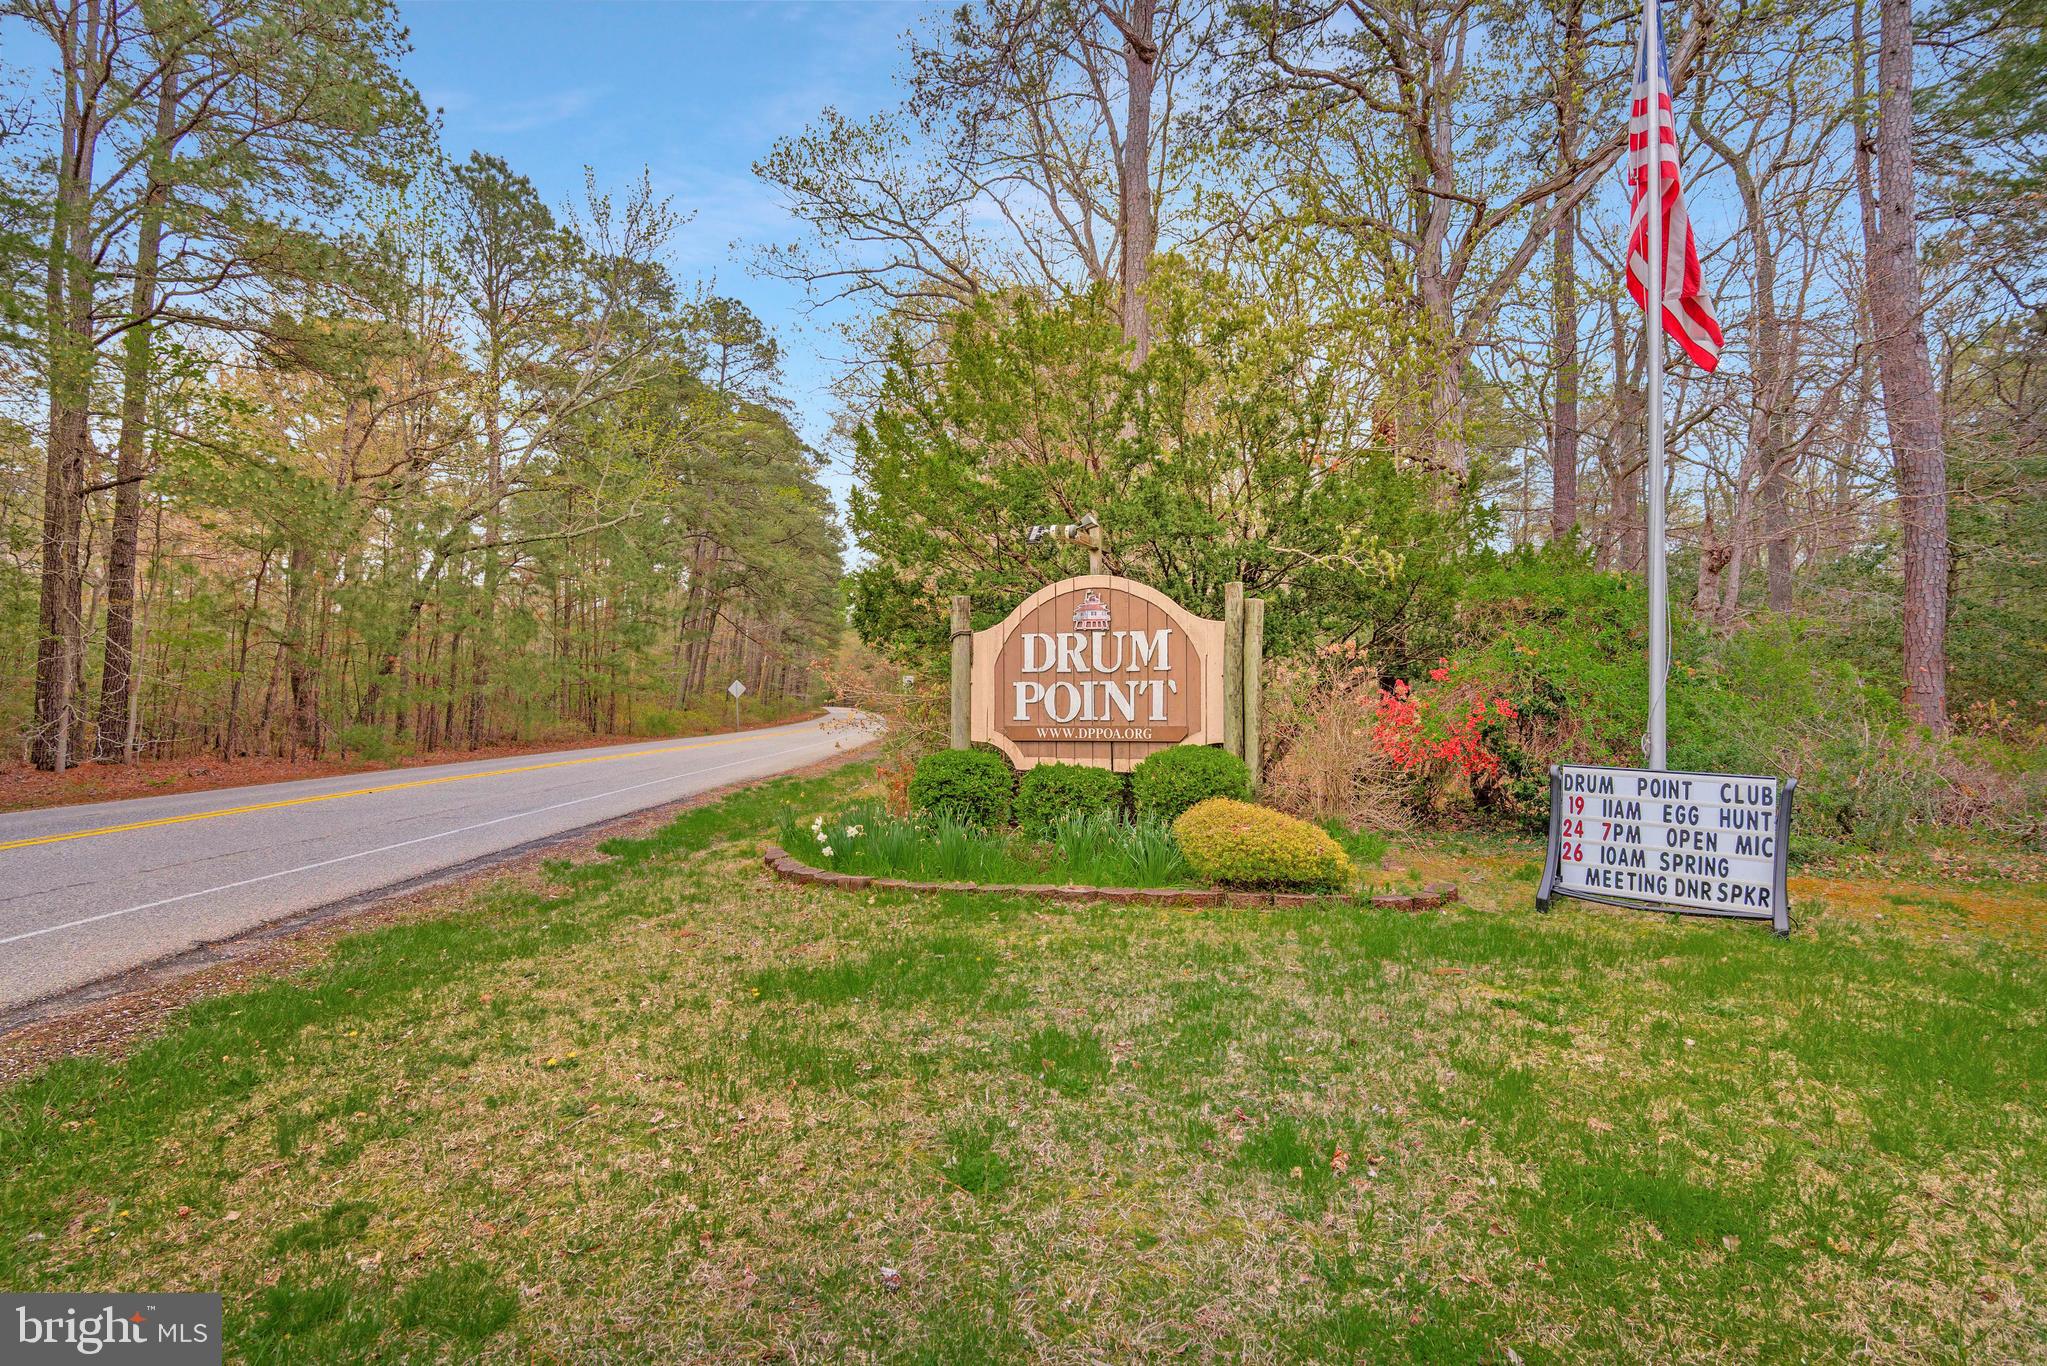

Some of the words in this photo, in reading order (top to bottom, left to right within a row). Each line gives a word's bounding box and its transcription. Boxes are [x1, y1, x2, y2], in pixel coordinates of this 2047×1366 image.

[1021, 629, 1173, 673] DRUM
[1013, 679, 1177, 723] POINT
[1036, 728, 1152, 739] WWW.DPPOA.ORG
[1564, 774, 1614, 794] DRUM
[1638, 778, 1692, 800] POINT
[1720, 783, 1773, 806] CLUB
[1569, 796, 1584, 815] 19
[1602, 799, 1641, 820] 11AM
[1663, 804, 1699, 825] EGG
[1720, 808, 1772, 831] HUNT
[1563, 819, 1584, 838] 24
[1602, 822, 1641, 844] 7PM
[1666, 828, 1717, 852] OPEN
[1735, 836, 1773, 857] MIC
[1562, 841, 1583, 861] 26
[1601, 846, 1645, 868] 10AM
[1660, 852, 1729, 878] SPRING
[1586, 868, 1667, 895] MEETING
[1676, 878, 1711, 901] DNR
[1717, 883, 1770, 907] SPKR
